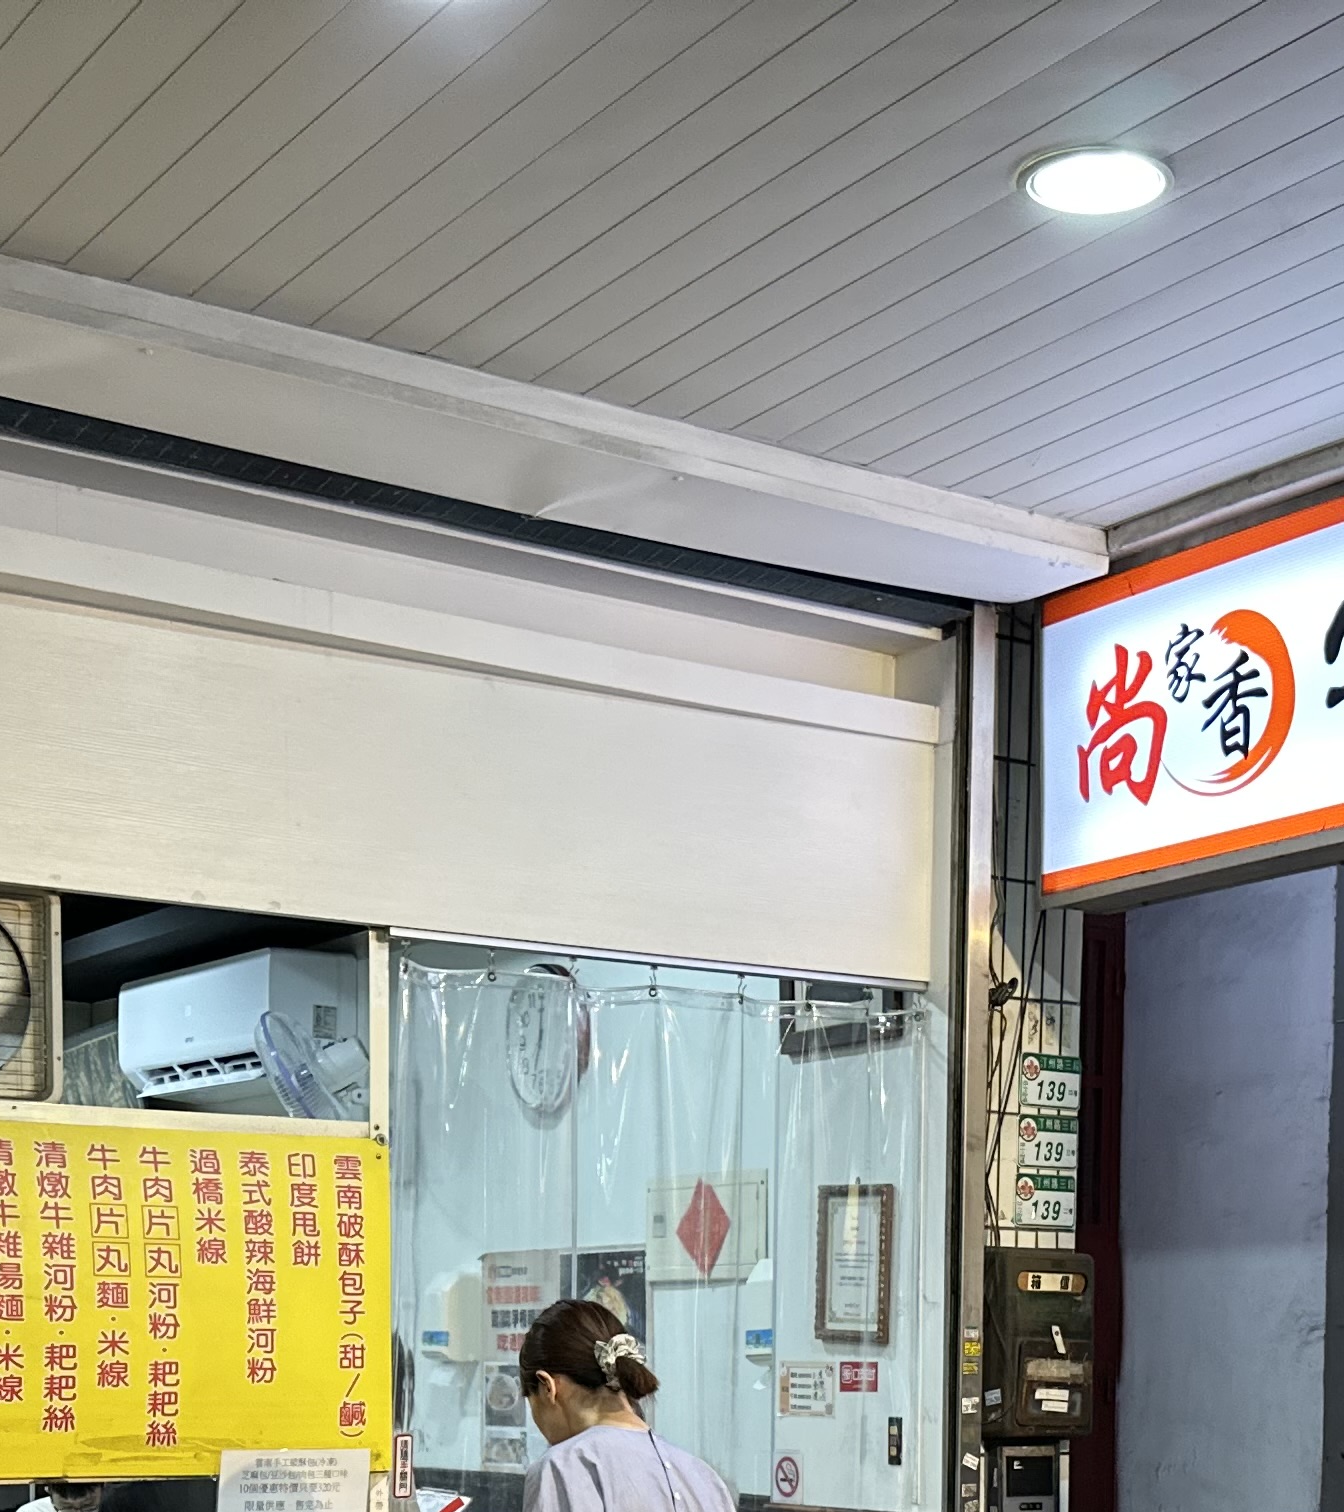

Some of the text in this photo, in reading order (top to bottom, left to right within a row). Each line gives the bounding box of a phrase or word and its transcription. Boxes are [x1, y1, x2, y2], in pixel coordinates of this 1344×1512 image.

[1078, 623, 1269, 805] 尚家香
[1037, 1080, 1066, 1101] 139
[1034, 1141, 1063, 1162] 139
[189, 1148, 228, 1265] 過橋米線
[288, 1152, 322, 1268] 印度甩餅
[1031, 1200, 1060, 1220] 139
[238, 1150, 277, 1385] 泰式酸辣海鮮河粉
[244, 1500, 285, 1511] 限量供應
